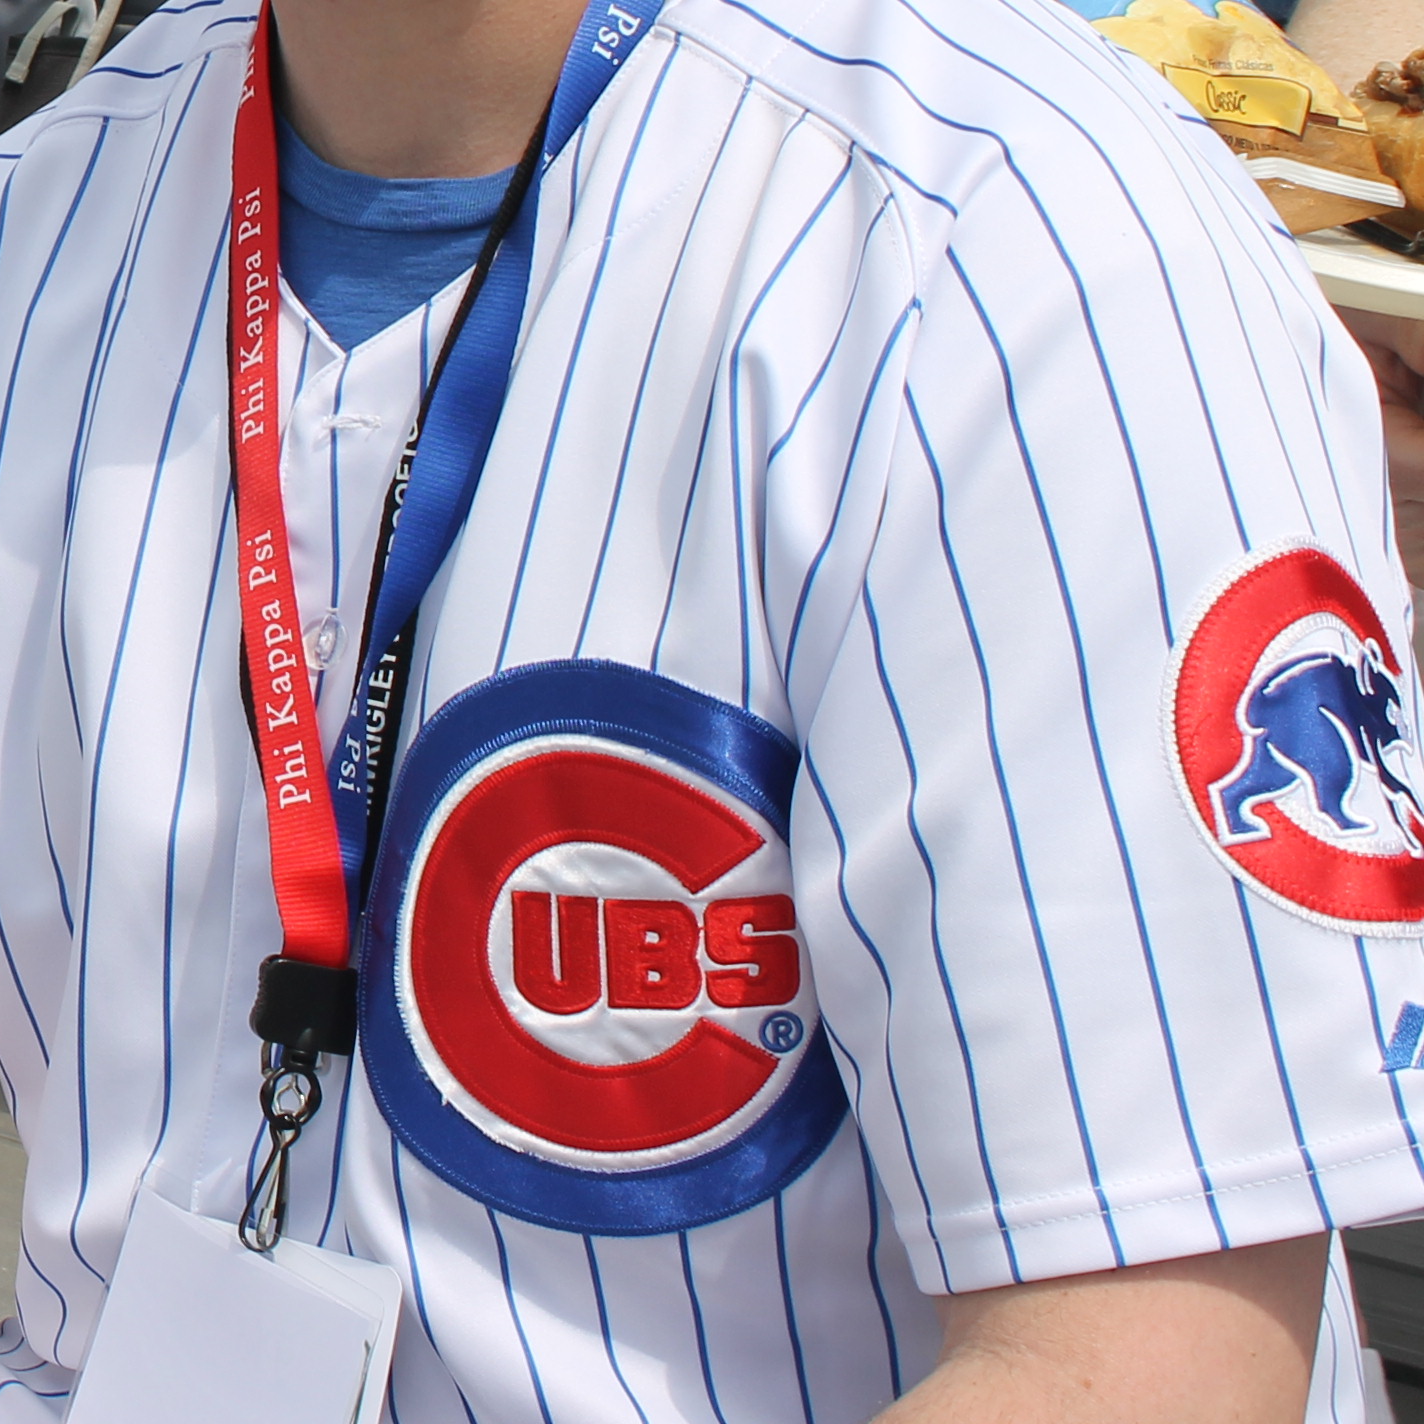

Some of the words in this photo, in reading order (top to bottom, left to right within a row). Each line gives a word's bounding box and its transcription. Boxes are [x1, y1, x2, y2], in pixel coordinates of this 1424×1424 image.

[592, 3, 642, 66] Psi
[238, 186, 261, 246] Psi
[240, 249, 269, 365] Kappa
[240, 377, 264, 444] Phi
[246, 530, 277, 591] Psi
[262, 598, 299, 731] Kappa
[274, 740, 312, 809] Phi
[338, 735, 362, 794] Psi
[411, 750, 801, 1152] CUBS
